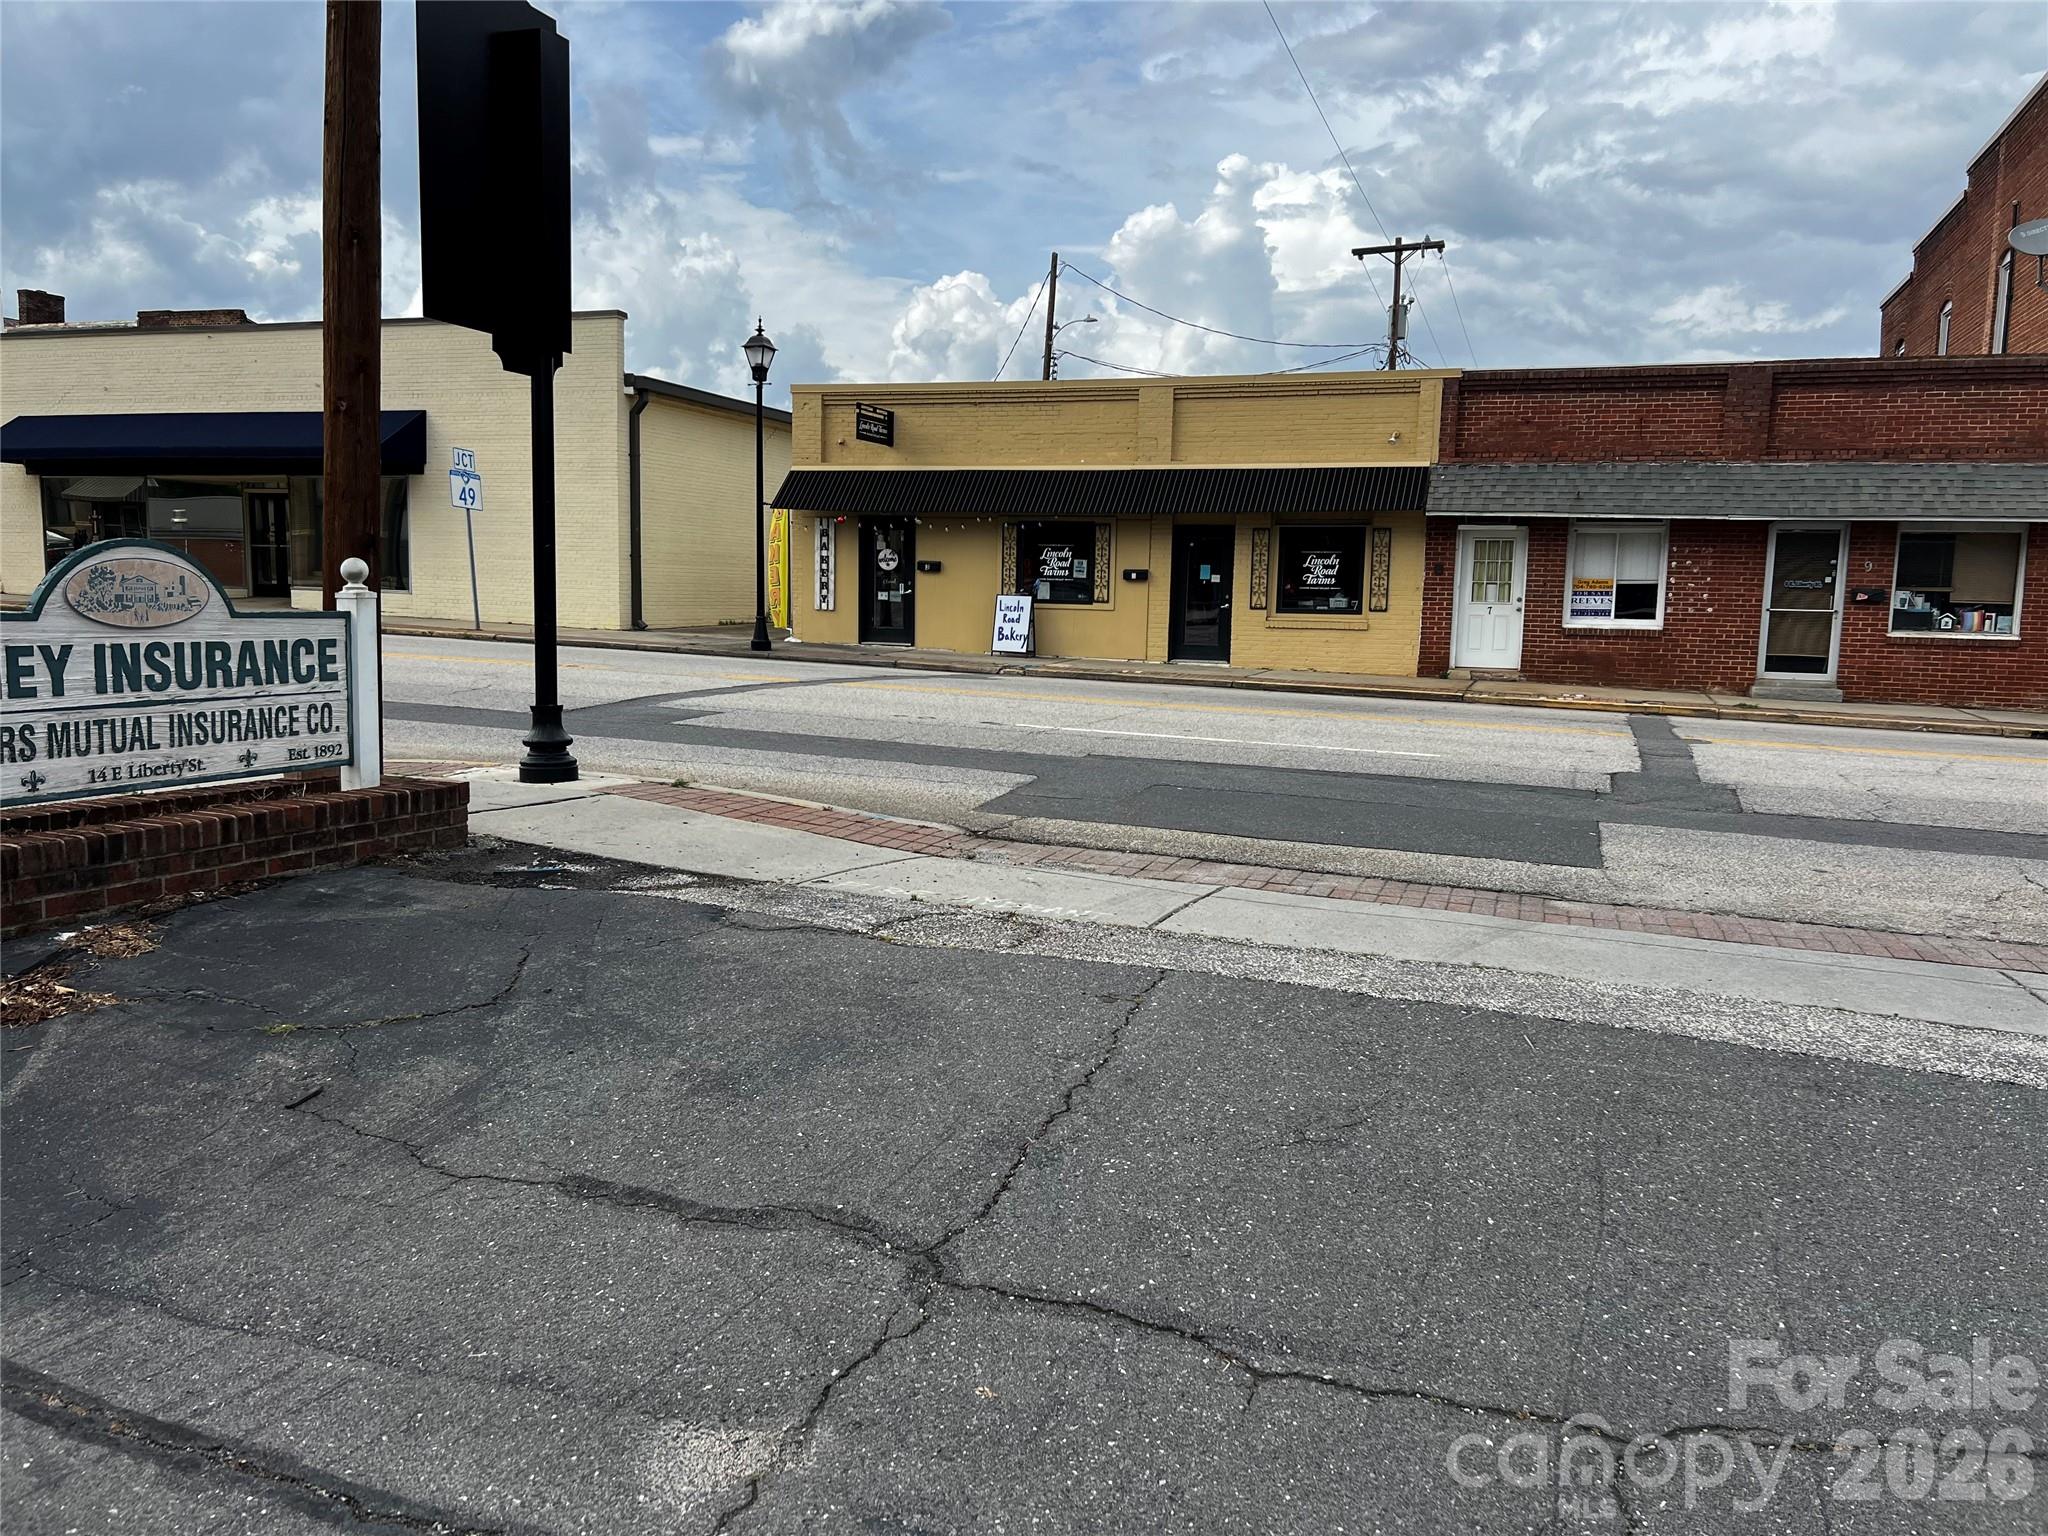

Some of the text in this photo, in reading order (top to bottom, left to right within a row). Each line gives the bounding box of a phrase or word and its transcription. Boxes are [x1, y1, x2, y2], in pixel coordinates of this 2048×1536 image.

[455, 452, 473, 469] JCT
[459, 486, 476, 506] 49
[1040, 547, 1072, 560] Lincoln
[820, 528, 829, 604] BAKERY
[1047, 557, 1072, 570] Road
[1303, 554, 1340, 568] Lincoln
[1864, 561, 1873, 573] 9
[1040, 565, 1069, 577] Farms
[1311, 564, 1339, 578] Road
[1303, 573, 1337, 585] Farms
[999, 599, 1025, 613] Lincoln
[1351, 600, 1359, 611] 7
[1487, 606, 1493, 615] 7
[1002, 613, 1021, 624] Road
[997, 626, 1029, 649] Bakery
[0, 638, 339, 699] EY INSURANCE
[47, 716, 161, 760] MUTUAL
[169, 705, 300, 748] INSURANCE
[306, 702, 340, 735] CO.
[313, 743, 343, 759] 1892
[87, 758, 207, 784] 14 E Liberty St.
